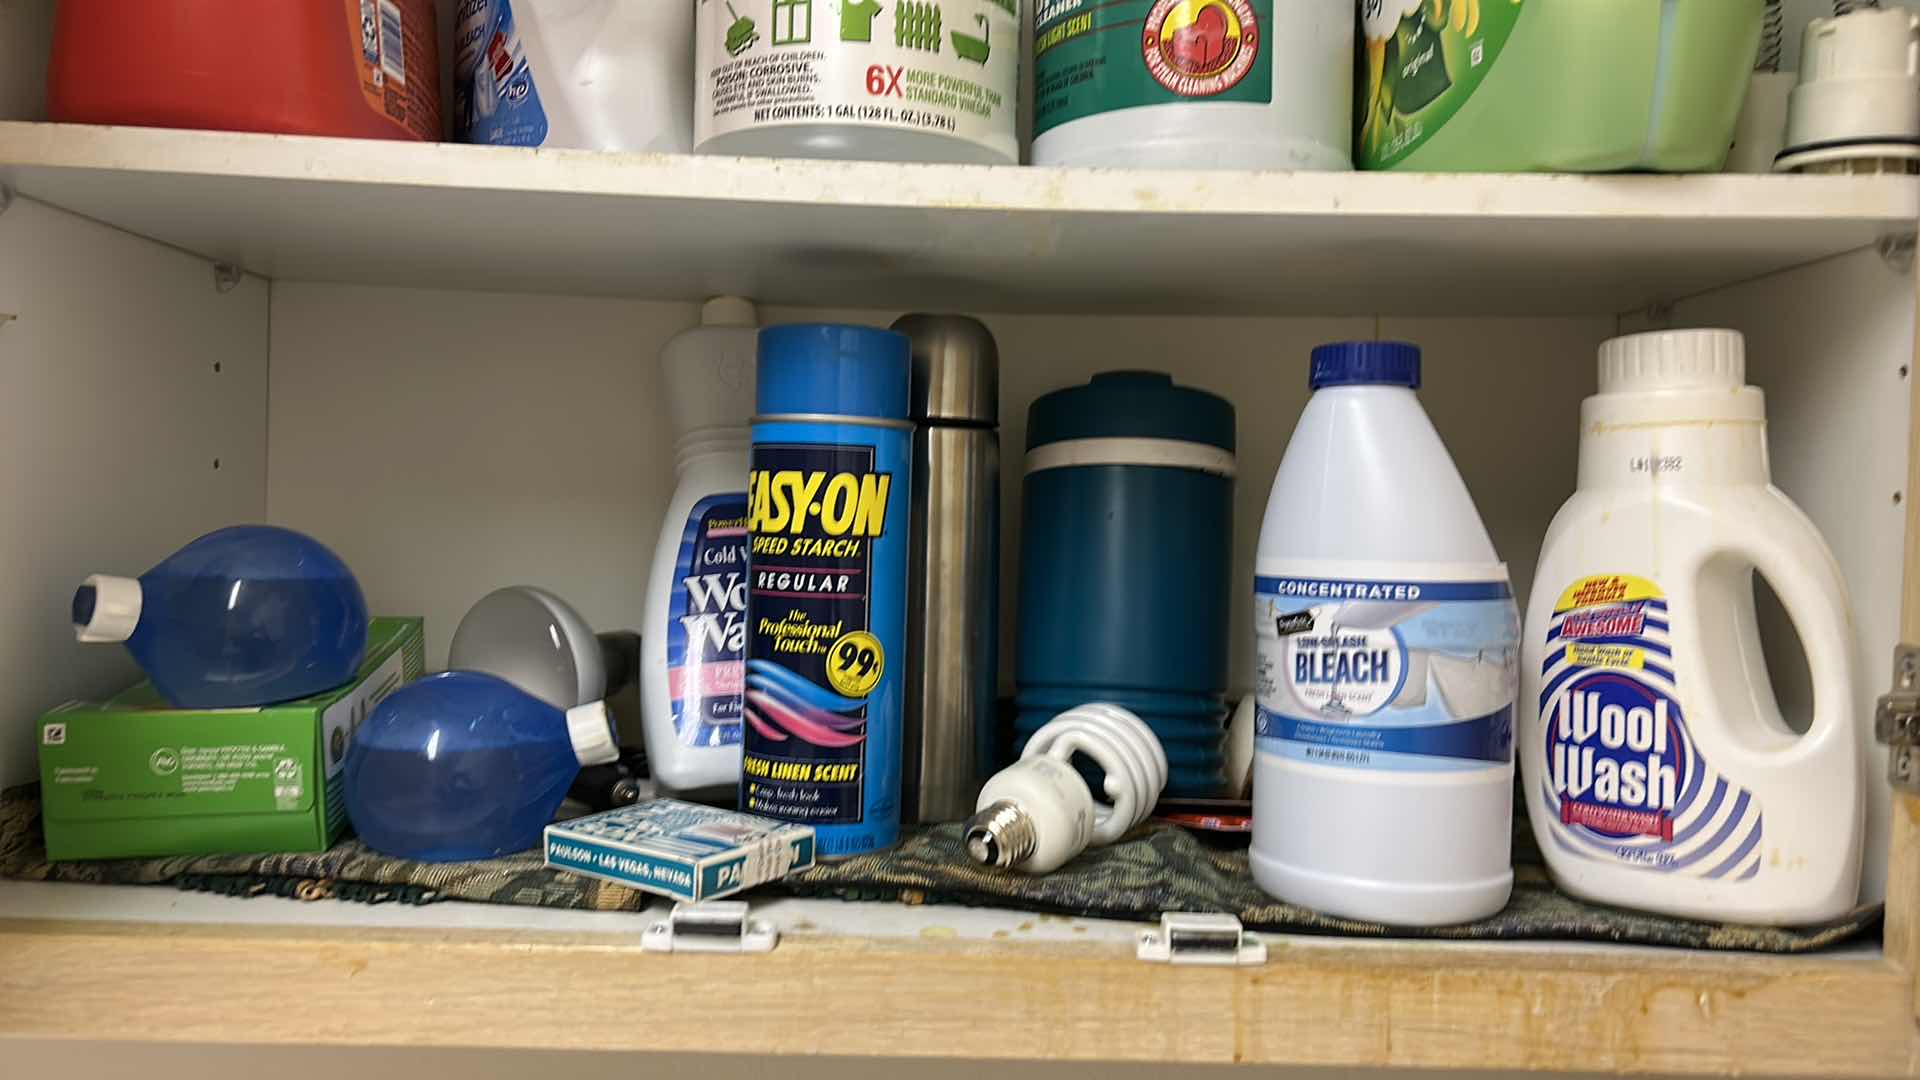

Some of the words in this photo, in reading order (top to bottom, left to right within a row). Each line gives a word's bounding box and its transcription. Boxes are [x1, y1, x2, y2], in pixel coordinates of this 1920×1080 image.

[866, 64, 904, 97] 6X
[906, 70, 937, 86] MORE
[754, 109, 771, 122] NET
[772, 105, 826, 119] CONTENTS:
[828, 105, 833, 117] 1
[835, 105, 855, 117] GAL
[857, 106, 882, 120] (128
[906, 86, 957, 109] STANDARD
[959, 96, 992, 119] VINEGAR
[704, 545, 736, 566] Cold
[753, 536, 788, 555] SPEED
[757, 572, 849, 593] REGULAR
[1278, 580, 1421, 600] CONCENTRATED
[789, 609, 807, 621] The
[1562, 614, 1643, 637] AWESOME
[758, 617, 844, 640] Professional
[1295, 649, 1389, 684] BLEACH
[1558, 688, 1668, 754] Wool
[771, 761, 812, 781] LINEN
[813, 763, 859, 782] SCENT
[1553, 742, 1677, 811] Wash
[550, 842, 592, 864] PAULSON
[598, 852, 617, 870] LAS
[653, 865, 692, 888] NEVADA
